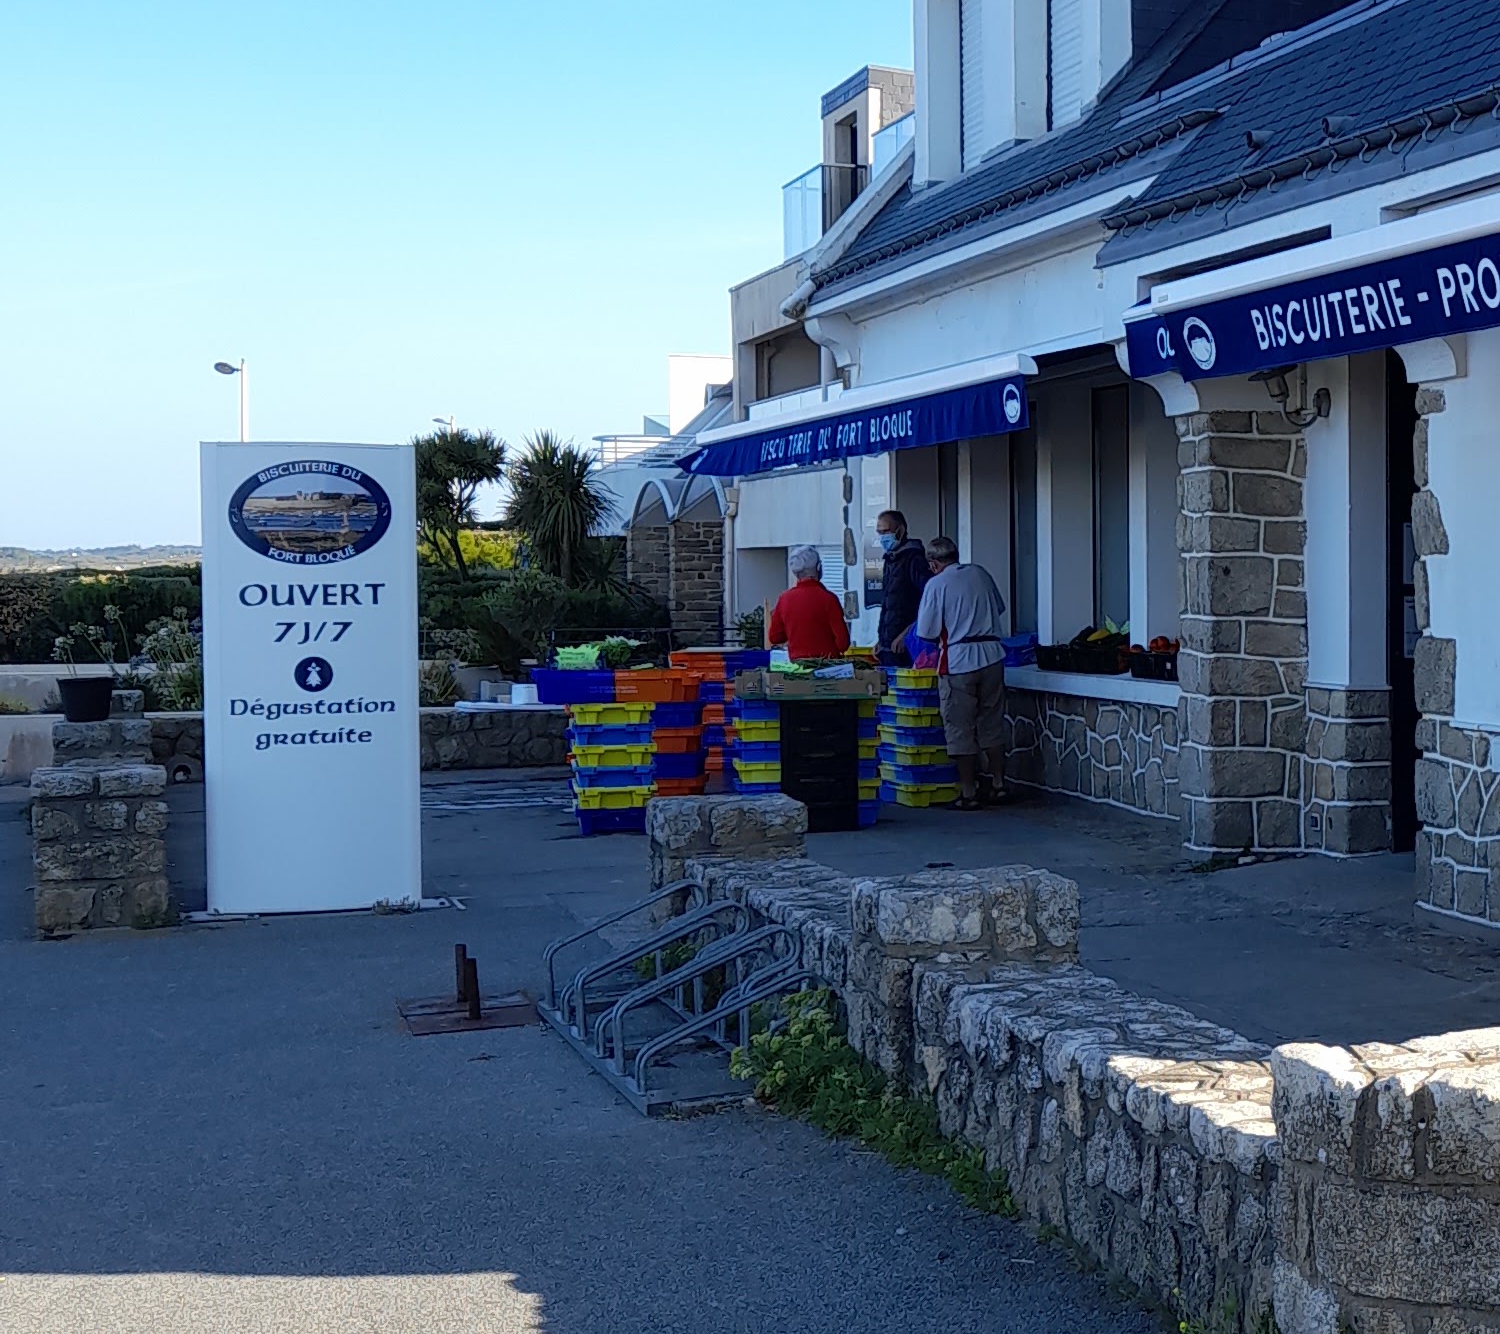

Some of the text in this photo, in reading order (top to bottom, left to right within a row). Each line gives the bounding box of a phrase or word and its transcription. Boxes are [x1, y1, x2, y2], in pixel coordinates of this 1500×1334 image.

[1250, 279, 1411, 351] BISCUITERIE
[836, 421, 862, 448] FORT
[870, 410, 912, 443] BLOQUE
[257, 461, 362, 483] BISCUITERIE DU
[267, 545, 356, 563] FORT BLOQUÉ
[238, 582, 386, 606] OUVERT
[230, 697, 396, 720] Dégustation
[255, 727, 372, 750] gratuite
